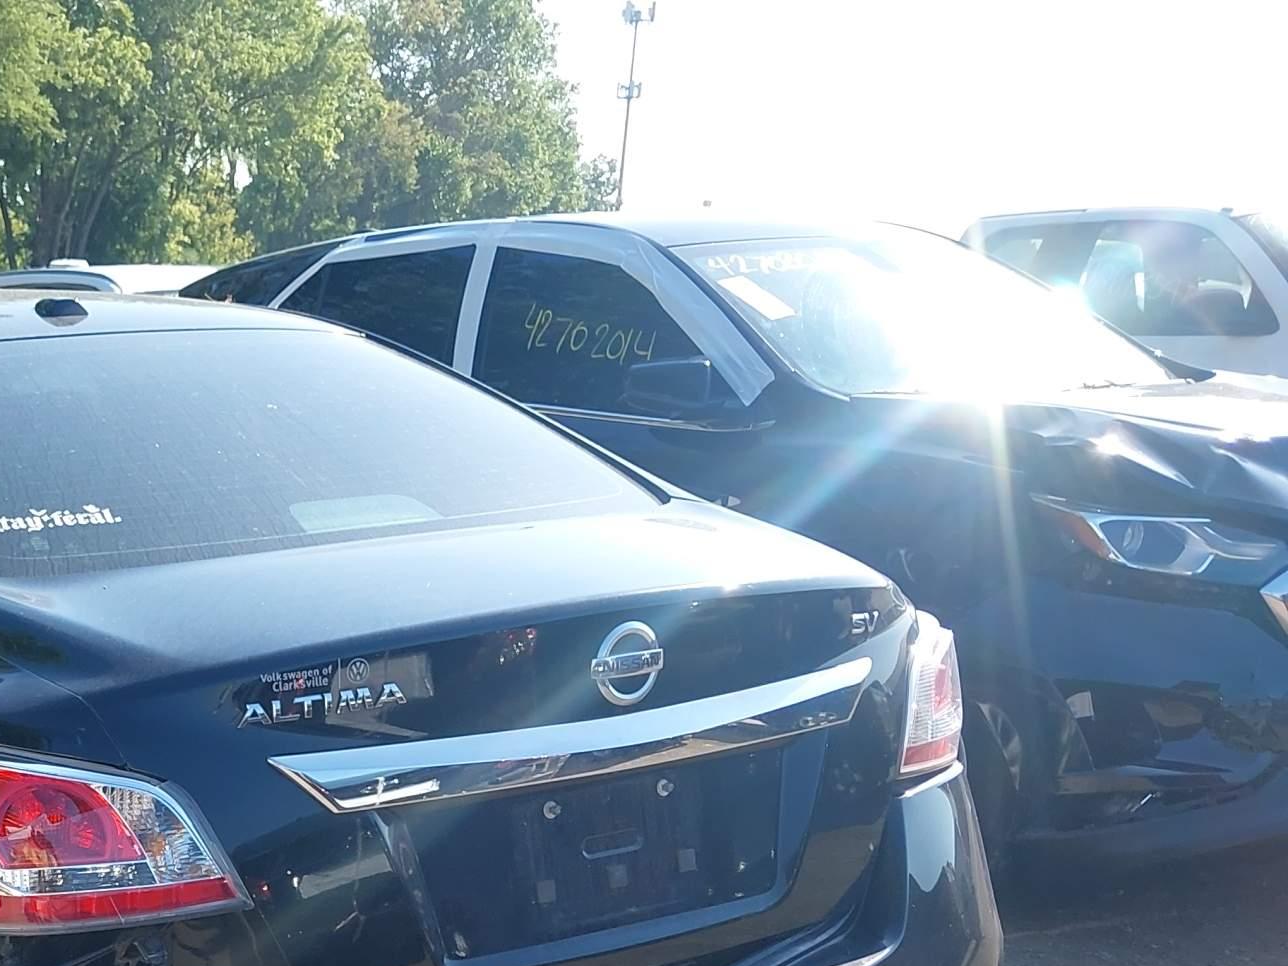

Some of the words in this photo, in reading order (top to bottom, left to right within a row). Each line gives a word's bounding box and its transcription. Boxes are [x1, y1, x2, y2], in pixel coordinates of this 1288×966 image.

[525, 302, 657, 366] 42702014
[851, 610, 880, 635] SV
[260, 668, 320, 683] Volkswagen
[321, 664, 333, 676] of
[598, 651, 661, 674] NISSAN
[272, 676, 330, 693] Clarksville
[237, 682, 408, 729] ALTIMA
